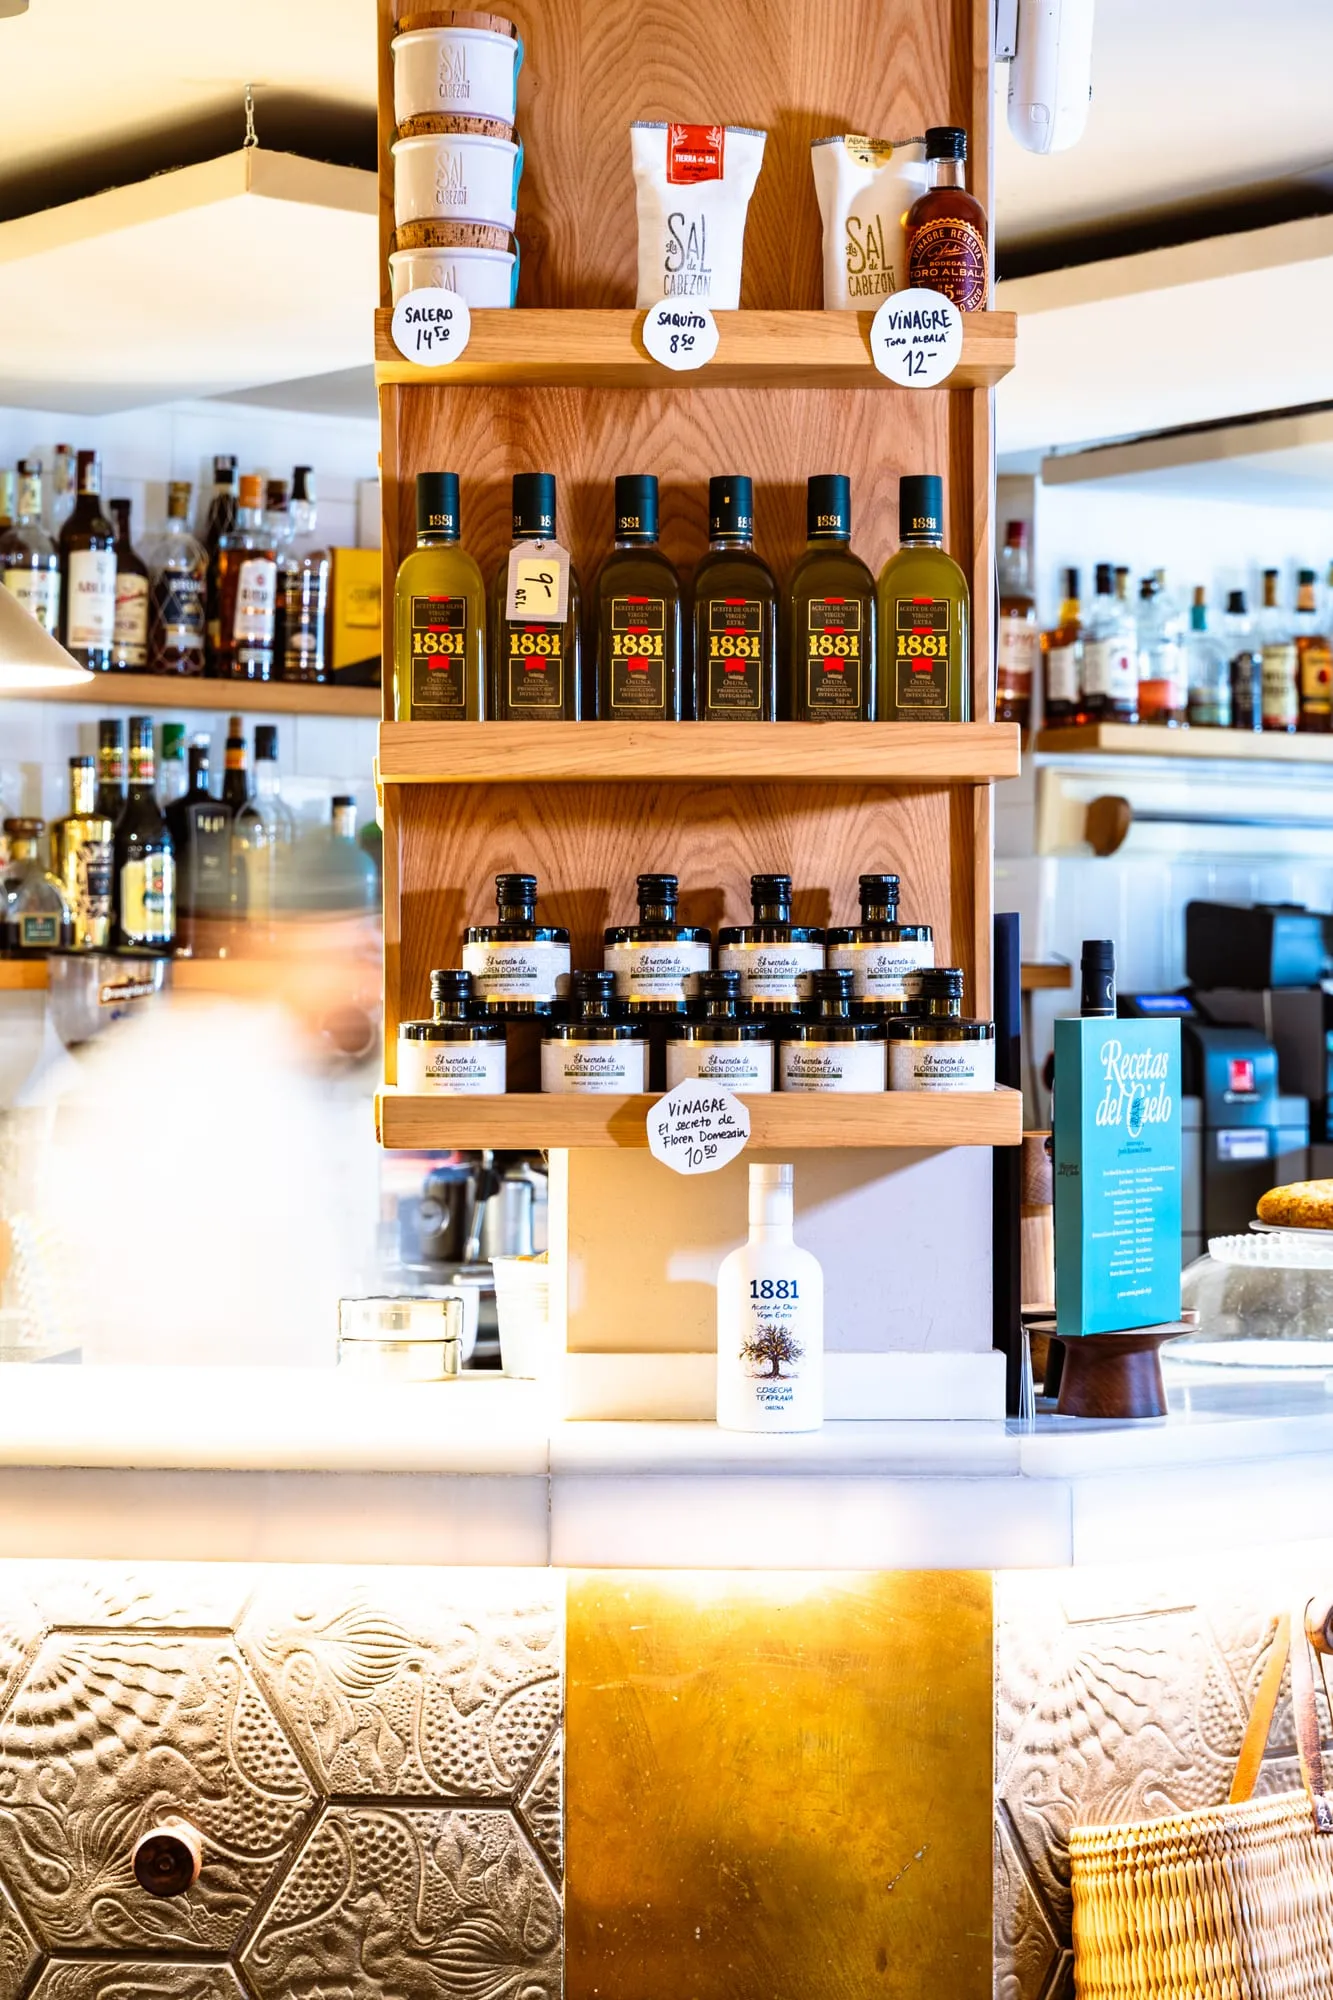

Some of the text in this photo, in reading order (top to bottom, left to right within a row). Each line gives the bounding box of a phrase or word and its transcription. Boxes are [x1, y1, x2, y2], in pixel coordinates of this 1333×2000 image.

[675, 154, 697, 163] TIERRA
[704, 155, 717, 164] SAL
[664, 212, 712, 273] SAL
[845, 214, 894, 275] SAL
[912, 228, 982, 260] VINAGRE RESERVA
[687, 258, 697, 271] de
[868, 259, 879, 271] de
[910, 268, 939, 278] TORO
[967, 288, 983, 309] SECO
[405, 306, 453, 324] SALERO
[889, 309, 953, 331] VINAGRE
[884, 337, 907, 348] TORO
[428, 514, 453, 527] 1881
[817, 515, 842, 528] 1881
[912, 517, 937, 530] 1881
[413, 633, 464, 654] 1881
[510, 633, 560, 655] 1881
[613, 635, 663, 655] 1881
[710, 636, 760, 657] 1881
[809, 635, 859, 656] 1881
[897, 635, 947, 656] 1881
[791, 957, 799, 965] de
[470, 1055, 478, 1063] de
[607, 1054, 615, 1063] de
[742, 1056, 749, 1064] de
[824, 1057, 832, 1065] de
[958, 1056, 965, 1064] de
[1100, 1039, 1169, 1085] Recetas
[668, 1097, 728, 1117] VINAGRE
[1095, 1081, 1172, 1138] del Cielo
[658, 1113, 735, 1136] El secreto de
[663, 1134, 694, 1149] Floren
[750, 1279, 800, 1300] 1881
[773, 1303, 781, 1311] de
[756, 1386, 793, 1394] COSECHA
